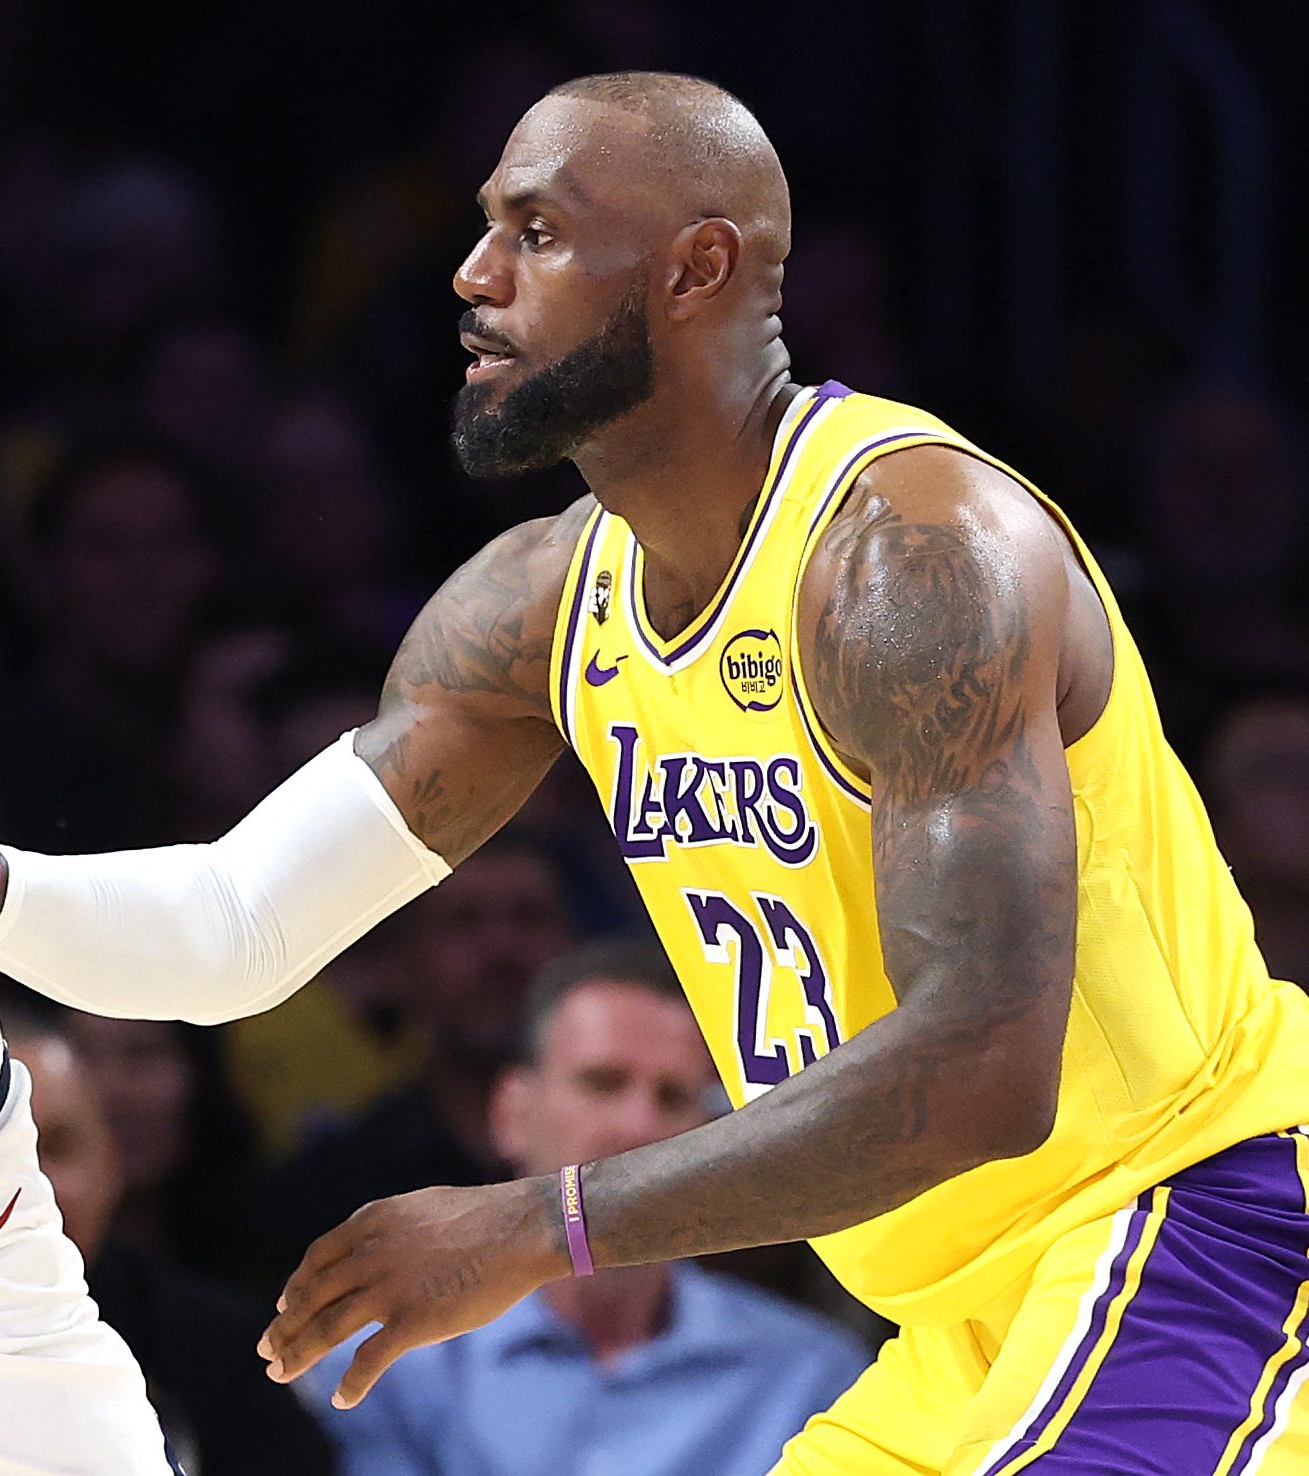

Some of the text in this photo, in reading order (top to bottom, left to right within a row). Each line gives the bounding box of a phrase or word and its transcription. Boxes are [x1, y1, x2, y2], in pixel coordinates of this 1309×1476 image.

[727, 651, 782, 686] bibigo
[741, 681, 765, 694] 비비고
[607, 721, 819, 868] LAKERS
[680, 886, 843, 1102] 23
